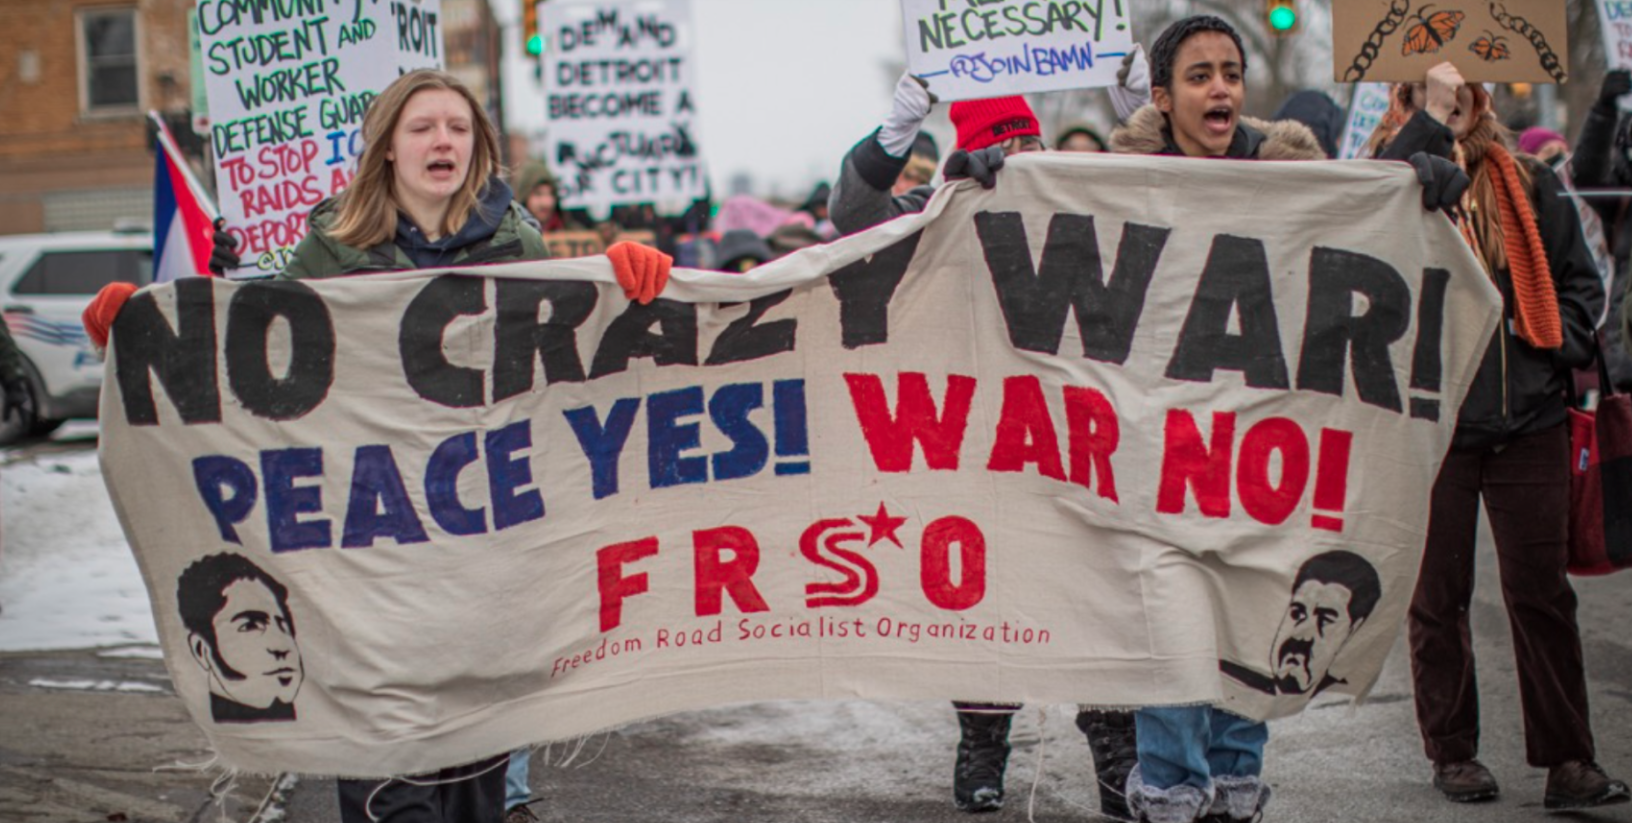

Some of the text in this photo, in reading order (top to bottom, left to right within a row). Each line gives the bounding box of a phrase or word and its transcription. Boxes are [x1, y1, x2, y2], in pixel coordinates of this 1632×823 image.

[208, 17, 329, 75] STUDENT
[338, 19, 376, 49] AND
[559, 9, 676, 51] DEMAND
[917, 0, 1126, 52] NECESSARY!
[235, 57, 346, 111] WORKER
[557, 58, 683, 86] DETROIT
[548, 90, 695, 119] BECOME A
[213, 106, 314, 159] DEFENSE
[220, 156, 256, 193] TO
[257, 139, 318, 180] STOP
[240, 176, 324, 219] RAIDS
[111, 210, 1451, 425] NO CRAZY WAR!
[192, 372, 1353, 552] PEACE YES! WAR NO!
[551, 616, 1050, 678] Freedom Road Socialist Organization
